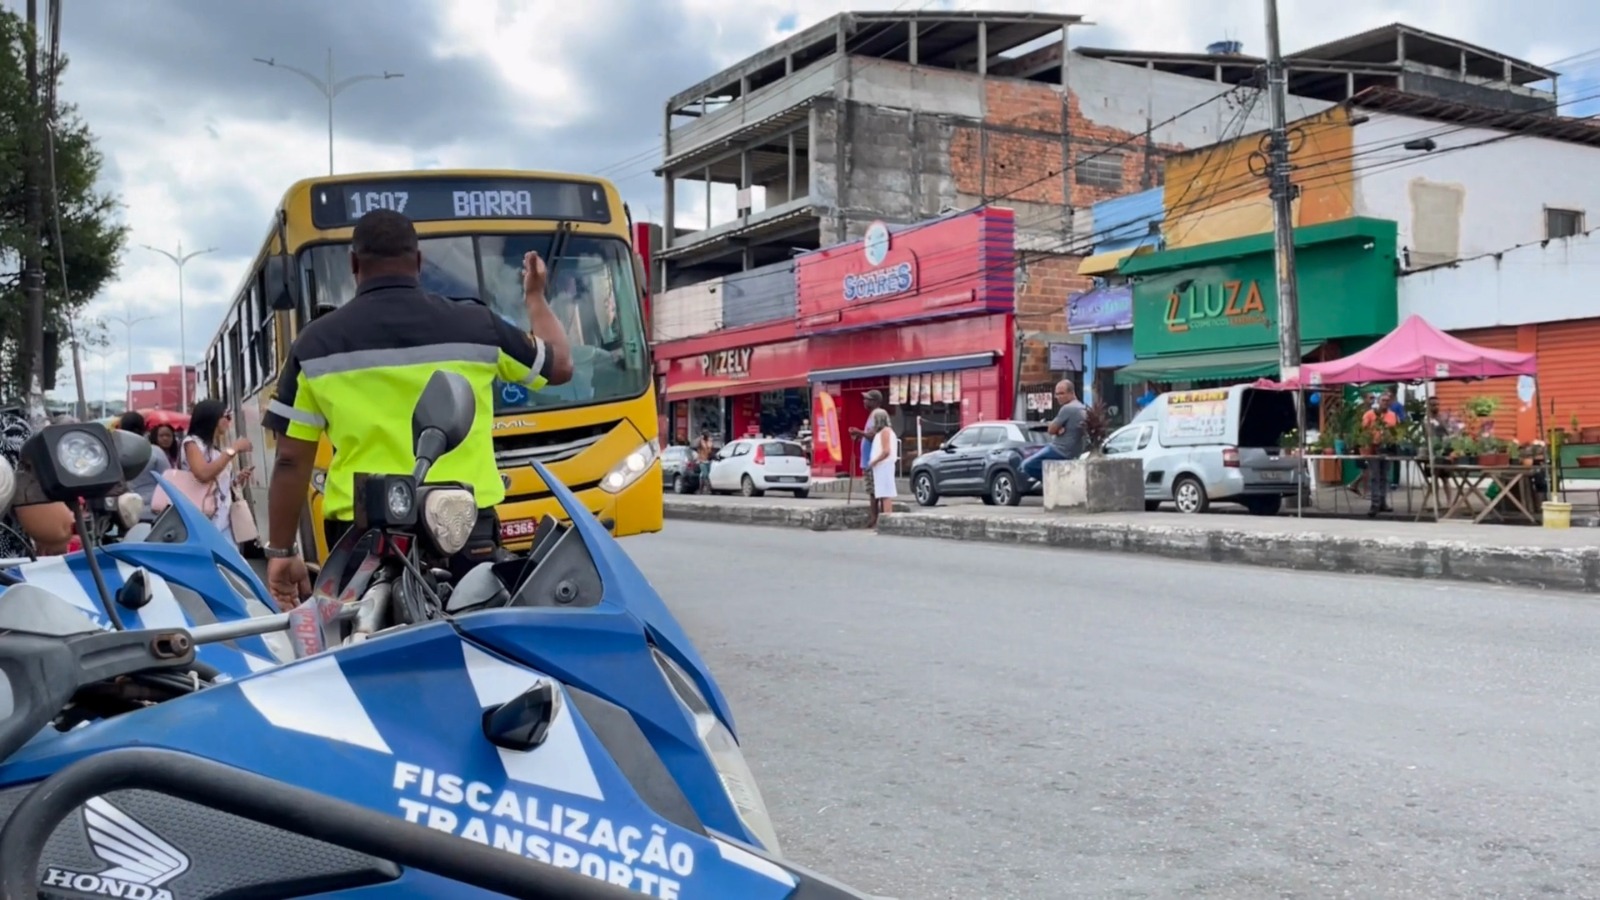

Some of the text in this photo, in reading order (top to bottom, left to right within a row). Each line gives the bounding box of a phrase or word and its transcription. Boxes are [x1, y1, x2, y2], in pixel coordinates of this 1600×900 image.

[351, 191, 532, 218] 1607 BARRA
[843, 262, 912, 301] SOARES
[1189, 279, 1265, 319] LUZA
[393, 761, 695, 877] FISCALIZAÇÃO
[398, 798, 681, 900] TRANSPORTE
[43, 868, 174, 900] HONDA
